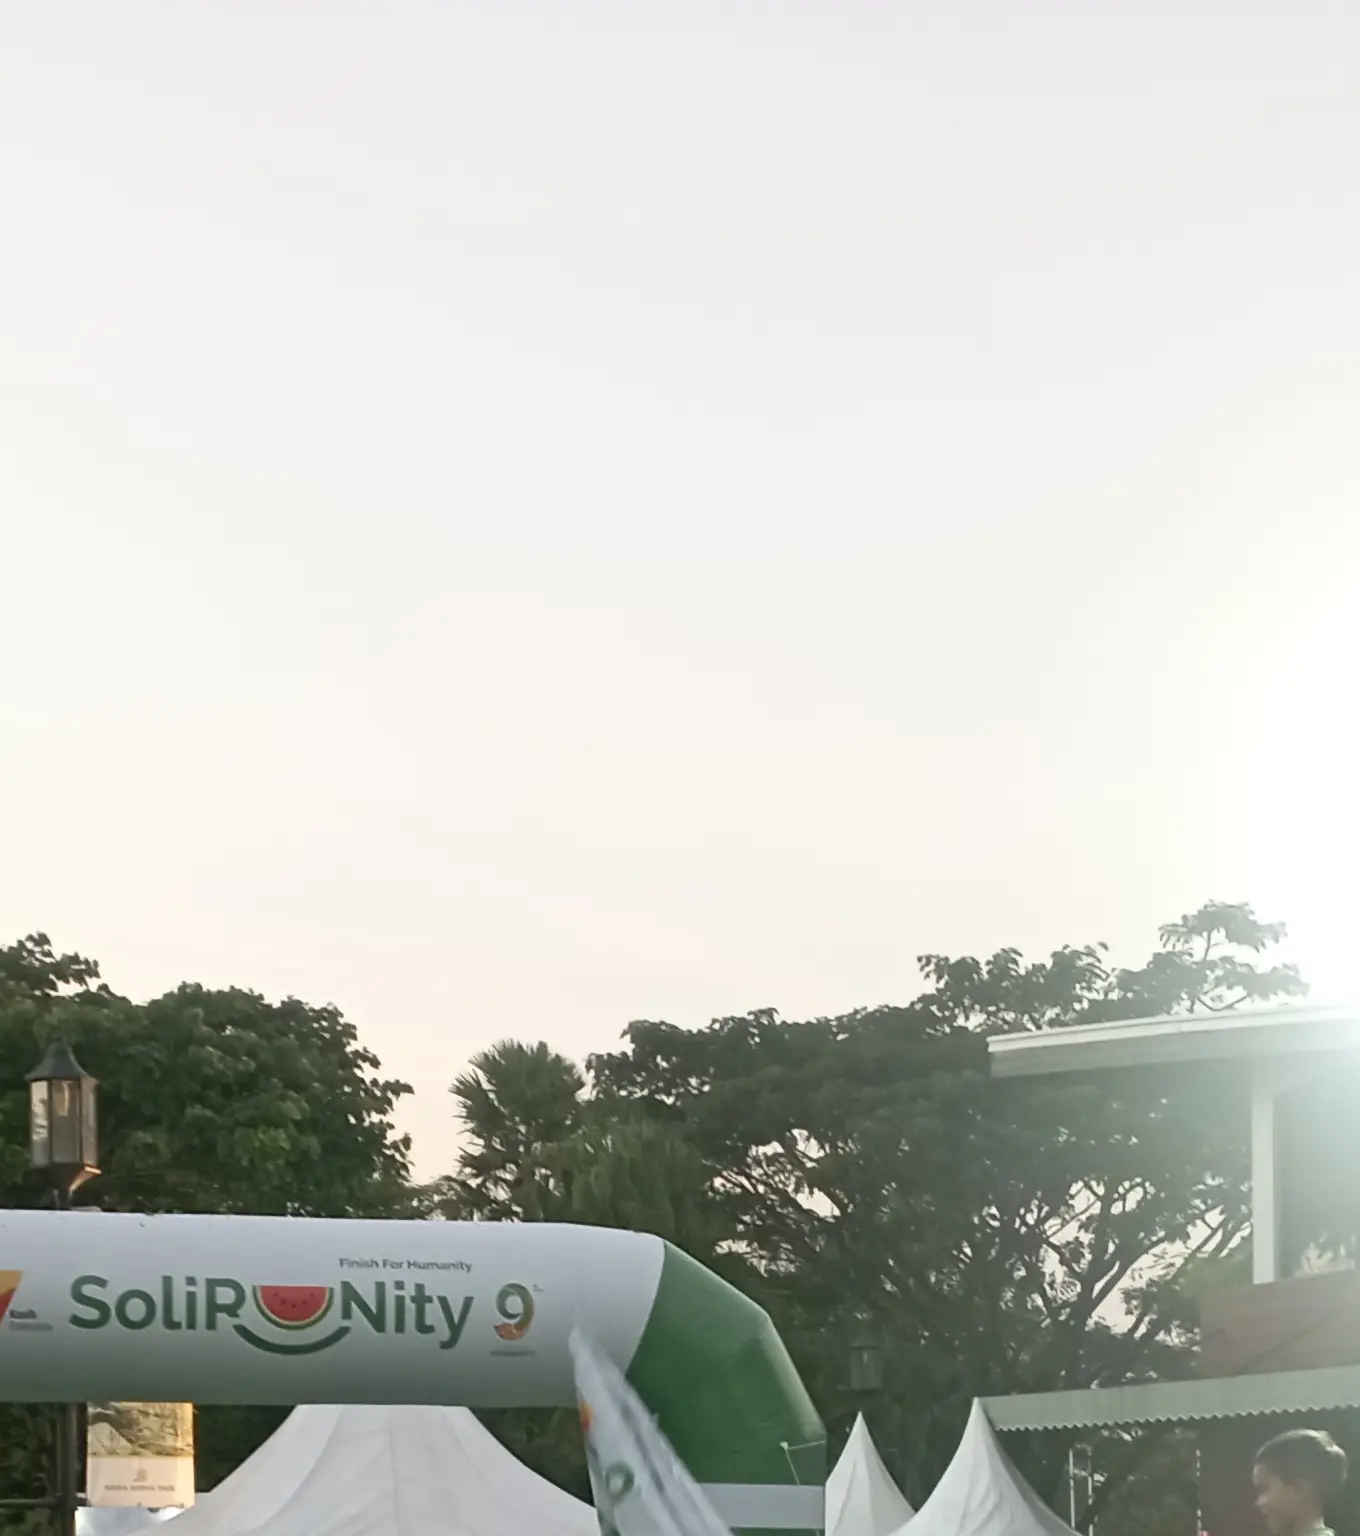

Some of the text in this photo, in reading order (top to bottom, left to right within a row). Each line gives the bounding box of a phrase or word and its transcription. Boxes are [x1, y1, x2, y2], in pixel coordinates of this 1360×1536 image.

[339, 1257, 472, 1274] Finish For Humanity
[493, 1282, 535, 1341] 9
